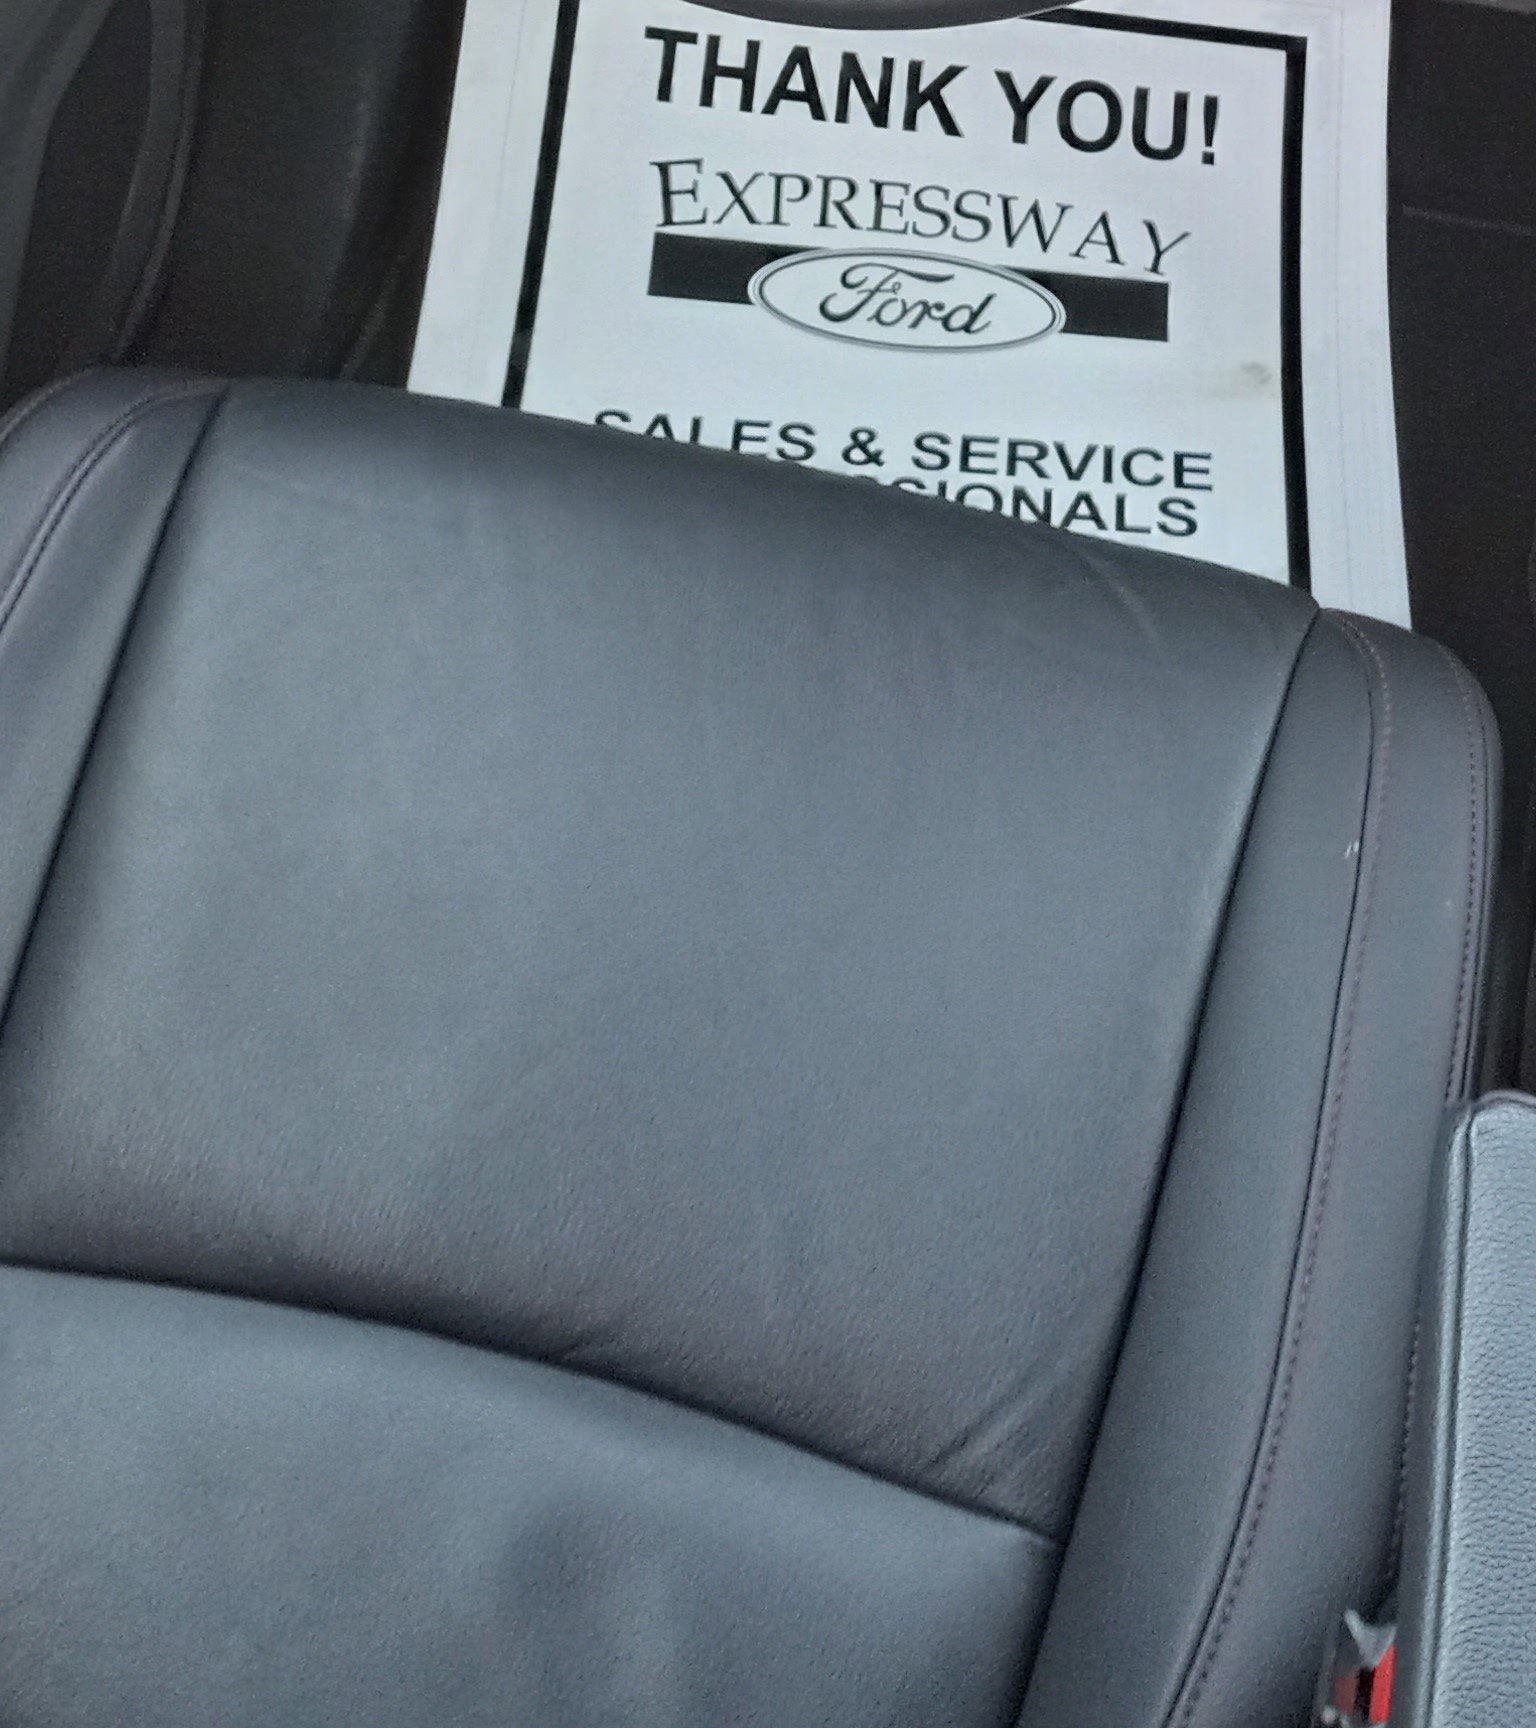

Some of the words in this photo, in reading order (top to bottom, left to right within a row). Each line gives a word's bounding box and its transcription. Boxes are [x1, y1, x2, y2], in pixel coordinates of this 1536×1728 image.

[644, 26, 969, 137] THANK
[994, 68, 1220, 165] YOU!
[819, 263, 997, 334] Ford
[841, 427, 885, 467] &
[913, 432, 1213, 491] SERVICE
